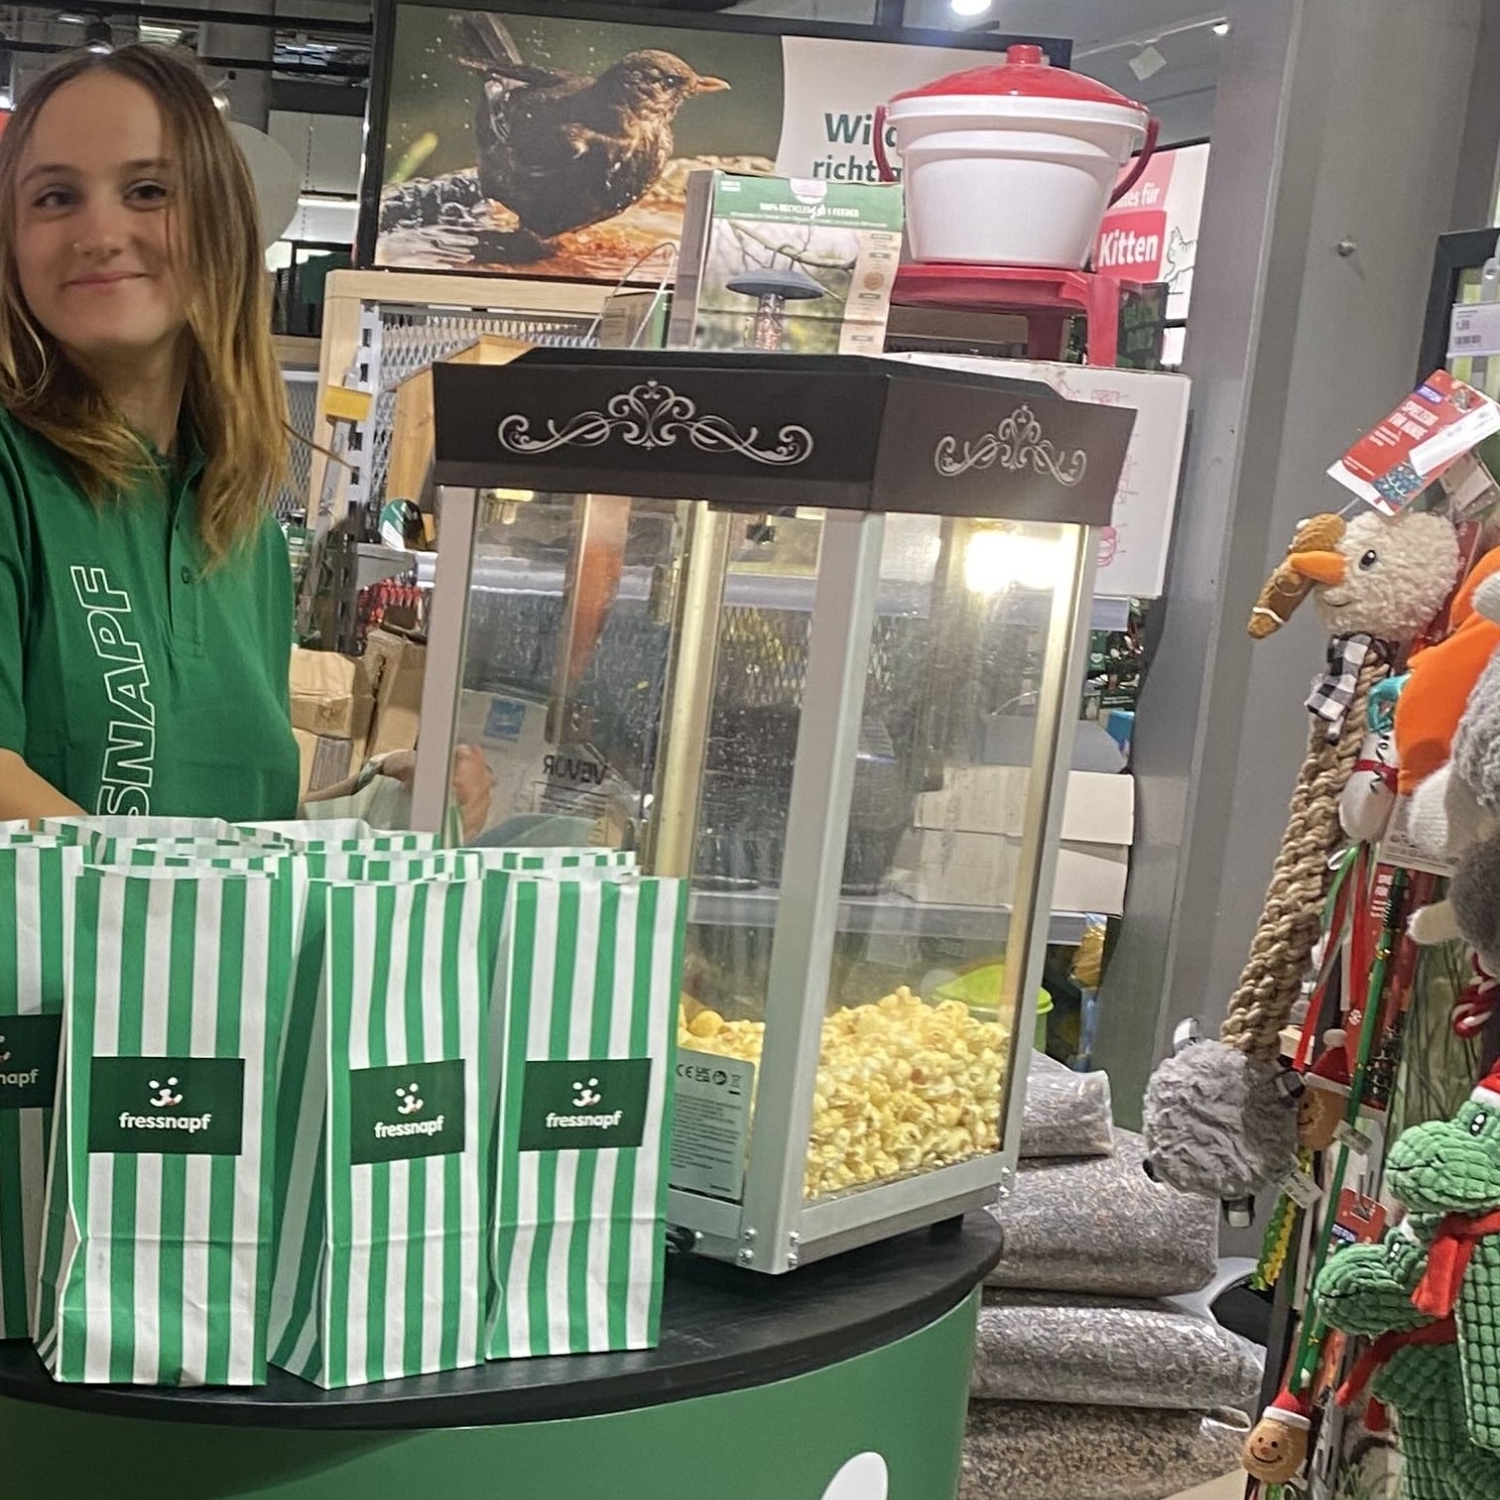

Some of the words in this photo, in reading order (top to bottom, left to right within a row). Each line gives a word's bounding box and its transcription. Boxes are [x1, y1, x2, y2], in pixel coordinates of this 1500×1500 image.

[824, 113, 897, 148] Wi
[812, 154, 903, 182] richt
[1141, 181, 1160, 205] für
[1098, 229, 1159, 267] Kitten
[119, 1112, 212, 1133] fressnapf
[374, 1115, 444, 1138] fressnapf
[545, 1110, 623, 1130] fressnapf
